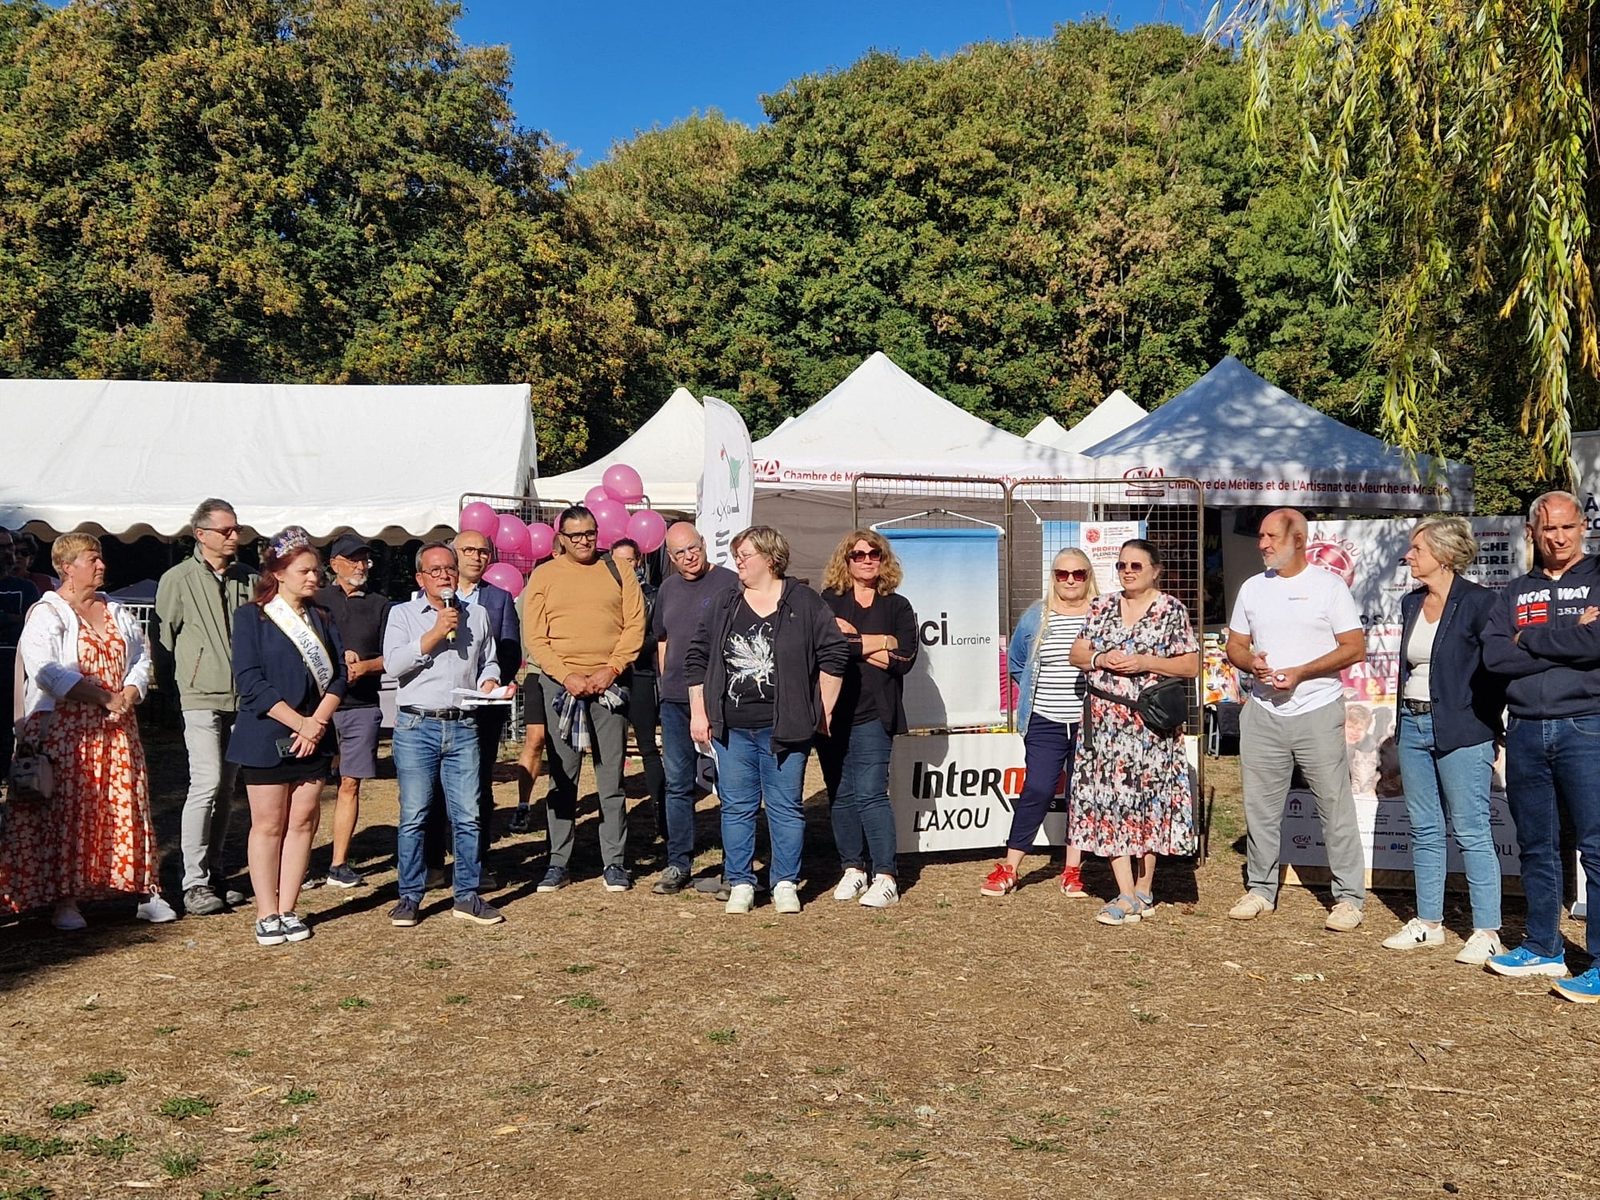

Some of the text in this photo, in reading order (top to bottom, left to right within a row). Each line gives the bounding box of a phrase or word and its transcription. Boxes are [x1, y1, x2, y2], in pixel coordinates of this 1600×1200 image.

[783, 470, 827, 481] Chambre
[830, 472, 841, 482] de
[1214, 479, 1226, 490] de
[1228, 478, 1263, 491] Métiers
[1265, 480, 1275, 491] et
[1278, 479, 1290, 491] de
[1293, 480, 1343, 492] L'Artisanat
[1345, 480, 1357, 493] de
[1360, 482, 1399, 494] Meurthe
[1401, 484, 1411, 494] et
[951, 634, 991, 646] Lorraine
[1385, 678, 1397, 694] E
[913, 807, 991, 832] LAXOU
